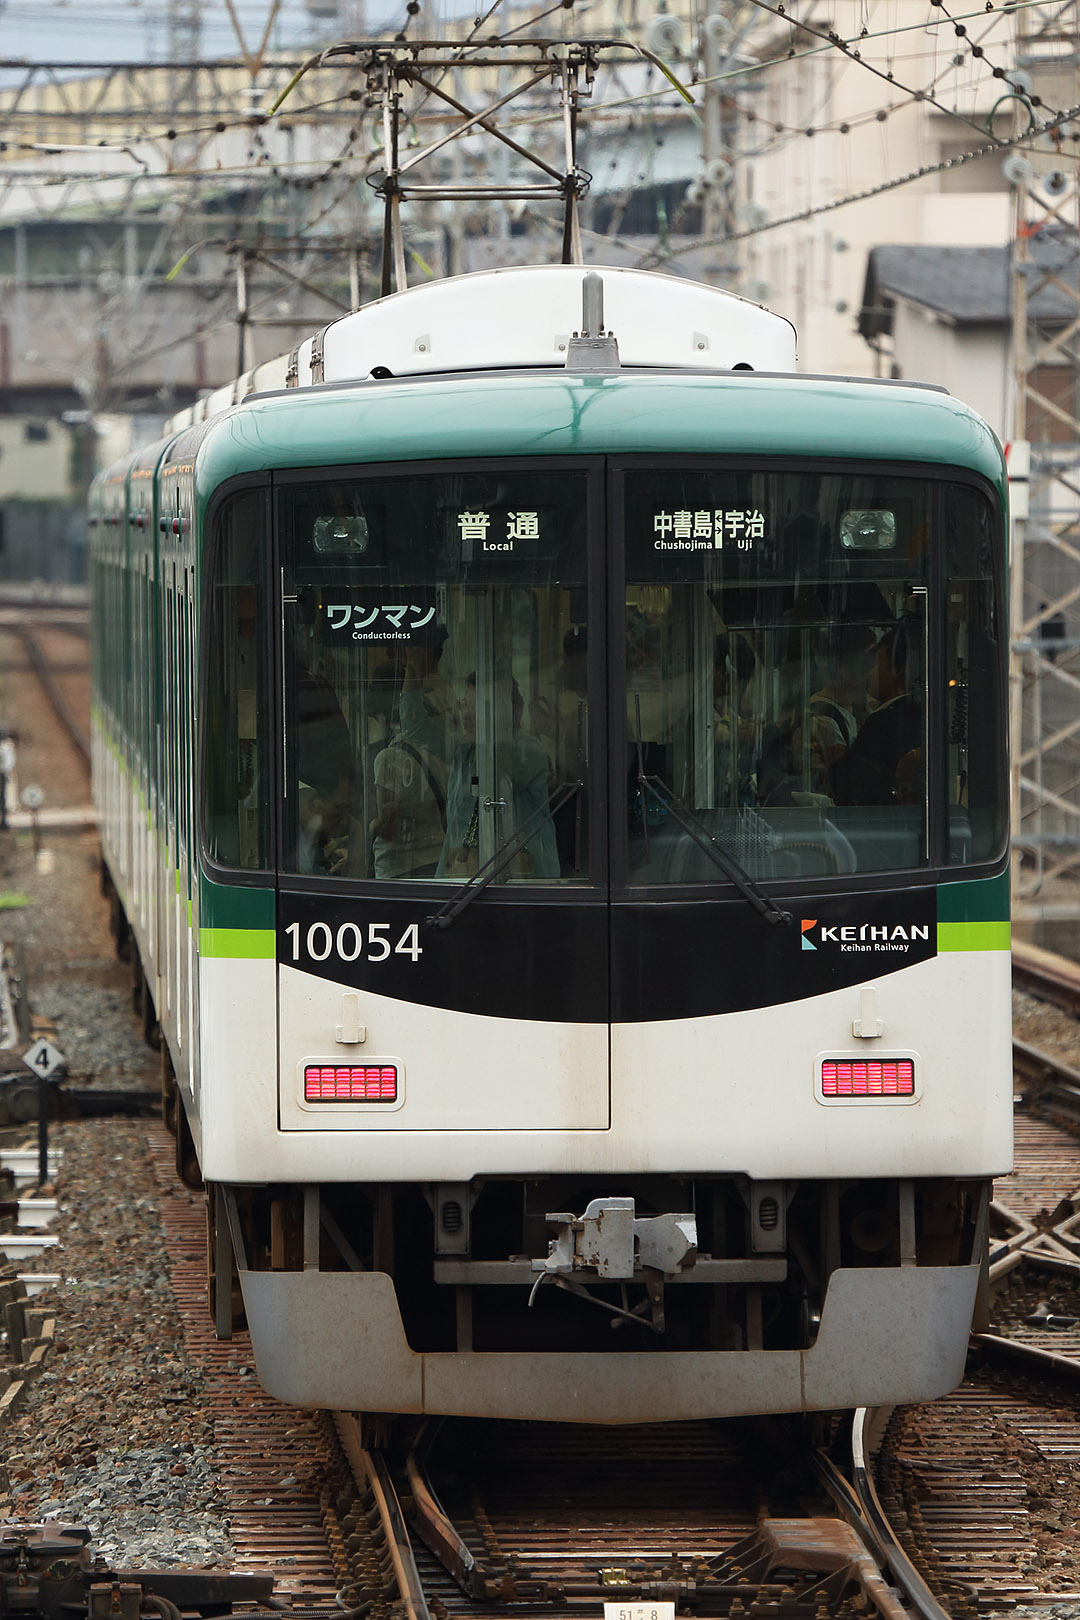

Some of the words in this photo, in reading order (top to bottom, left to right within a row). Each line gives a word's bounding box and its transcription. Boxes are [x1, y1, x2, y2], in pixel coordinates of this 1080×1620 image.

[457, 511, 540, 540] 普通
[654, 510, 713, 539] 中書島
[725, 510, 766, 538] 宇治
[483, 541, 514, 551] Local
[654, 540, 713, 552] Chushojima
[737, 540, 753, 551] Uji
[327, 604, 436, 630] ワンマン
[352, 631, 411, 640] Conductorless
[284, 922, 423, 962] 10054
[821, 924, 929, 941] KEIHAN
[841, 944, 872, 952] Keihan
[874, 943, 910, 952] Railway
[34, 1048, 49, 1069] 4
